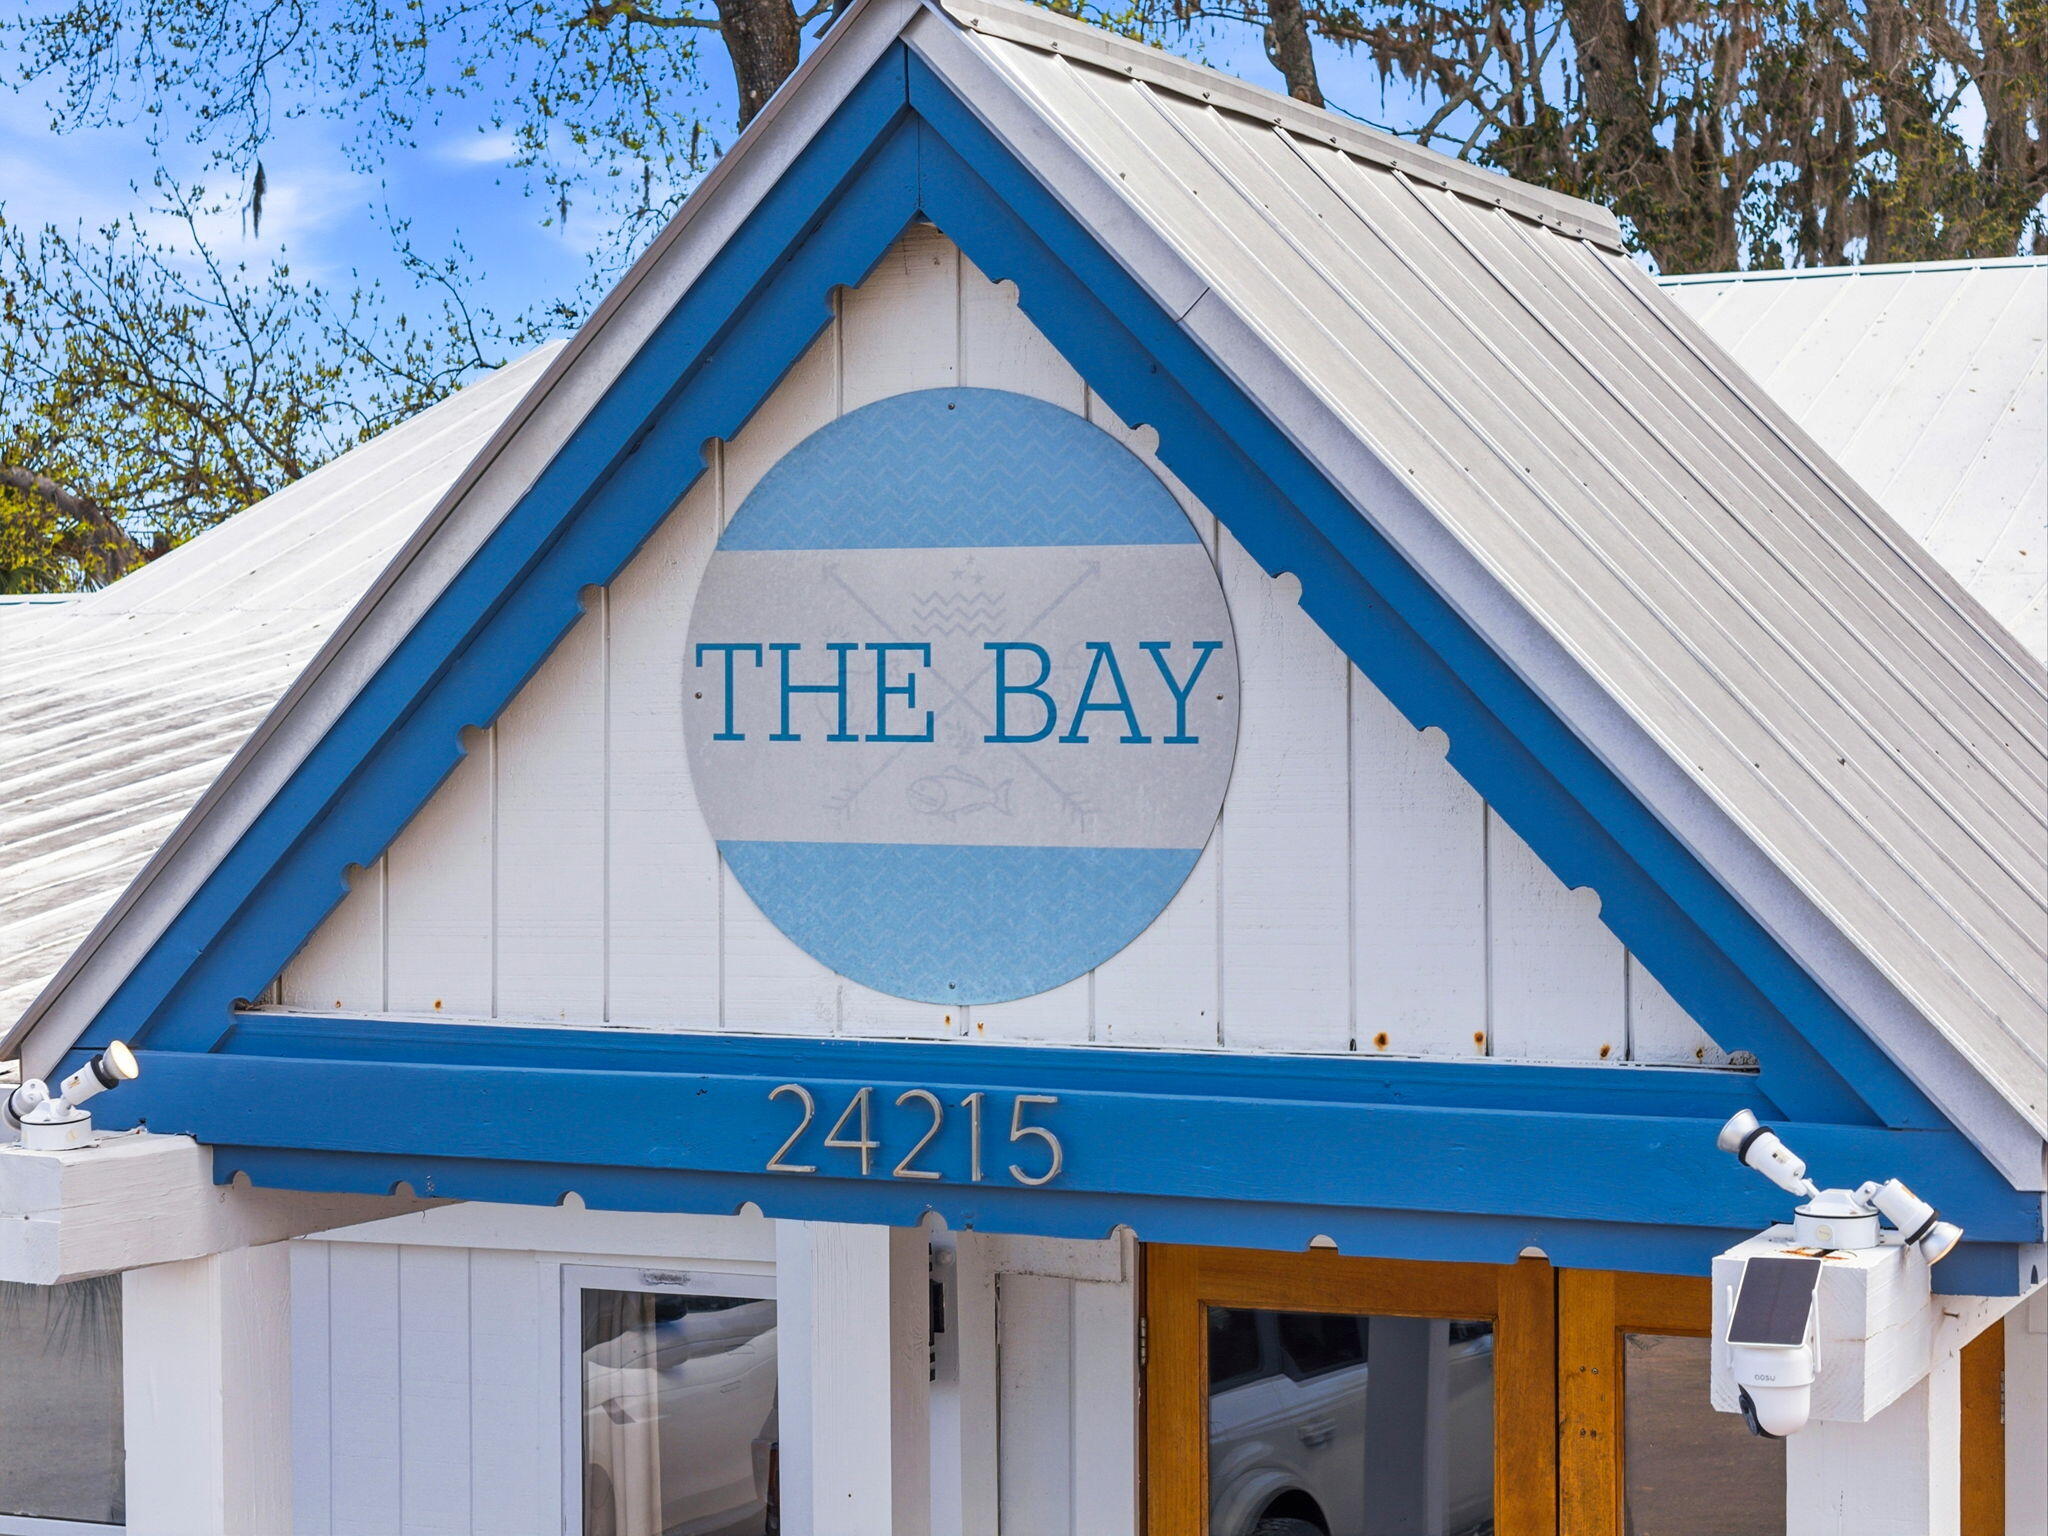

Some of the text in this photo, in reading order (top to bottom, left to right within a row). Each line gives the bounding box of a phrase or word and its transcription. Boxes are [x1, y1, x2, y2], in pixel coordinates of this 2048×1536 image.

[695, 641, 1223, 744] THE BAY
[766, 1083, 1063, 1186] 24215
